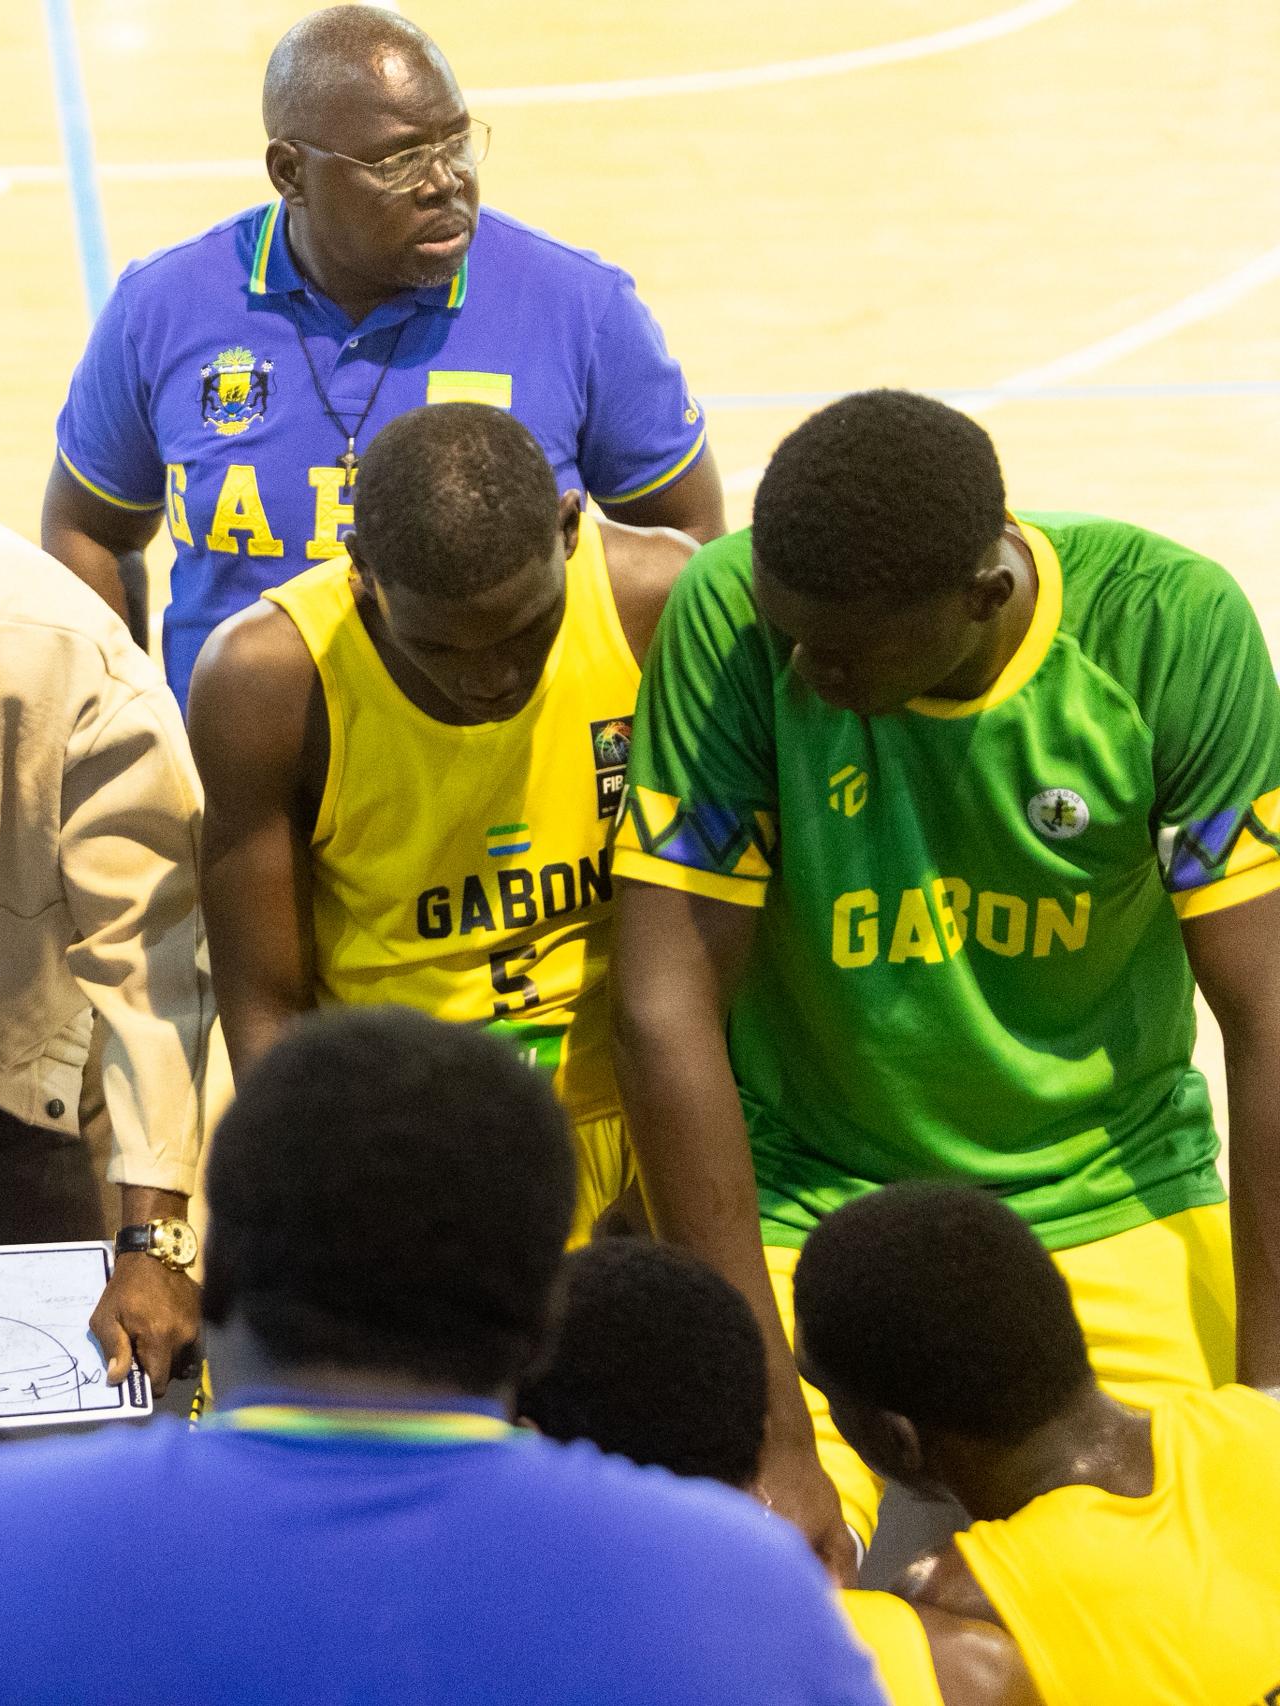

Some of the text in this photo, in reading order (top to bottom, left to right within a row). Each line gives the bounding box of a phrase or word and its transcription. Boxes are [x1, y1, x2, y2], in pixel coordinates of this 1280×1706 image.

[417, 847, 614, 940] GABON
[831, 877, 1091, 968] GABON
[488, 944, 540, 1016] 5
[132, 1370, 142, 1404] Coaching
